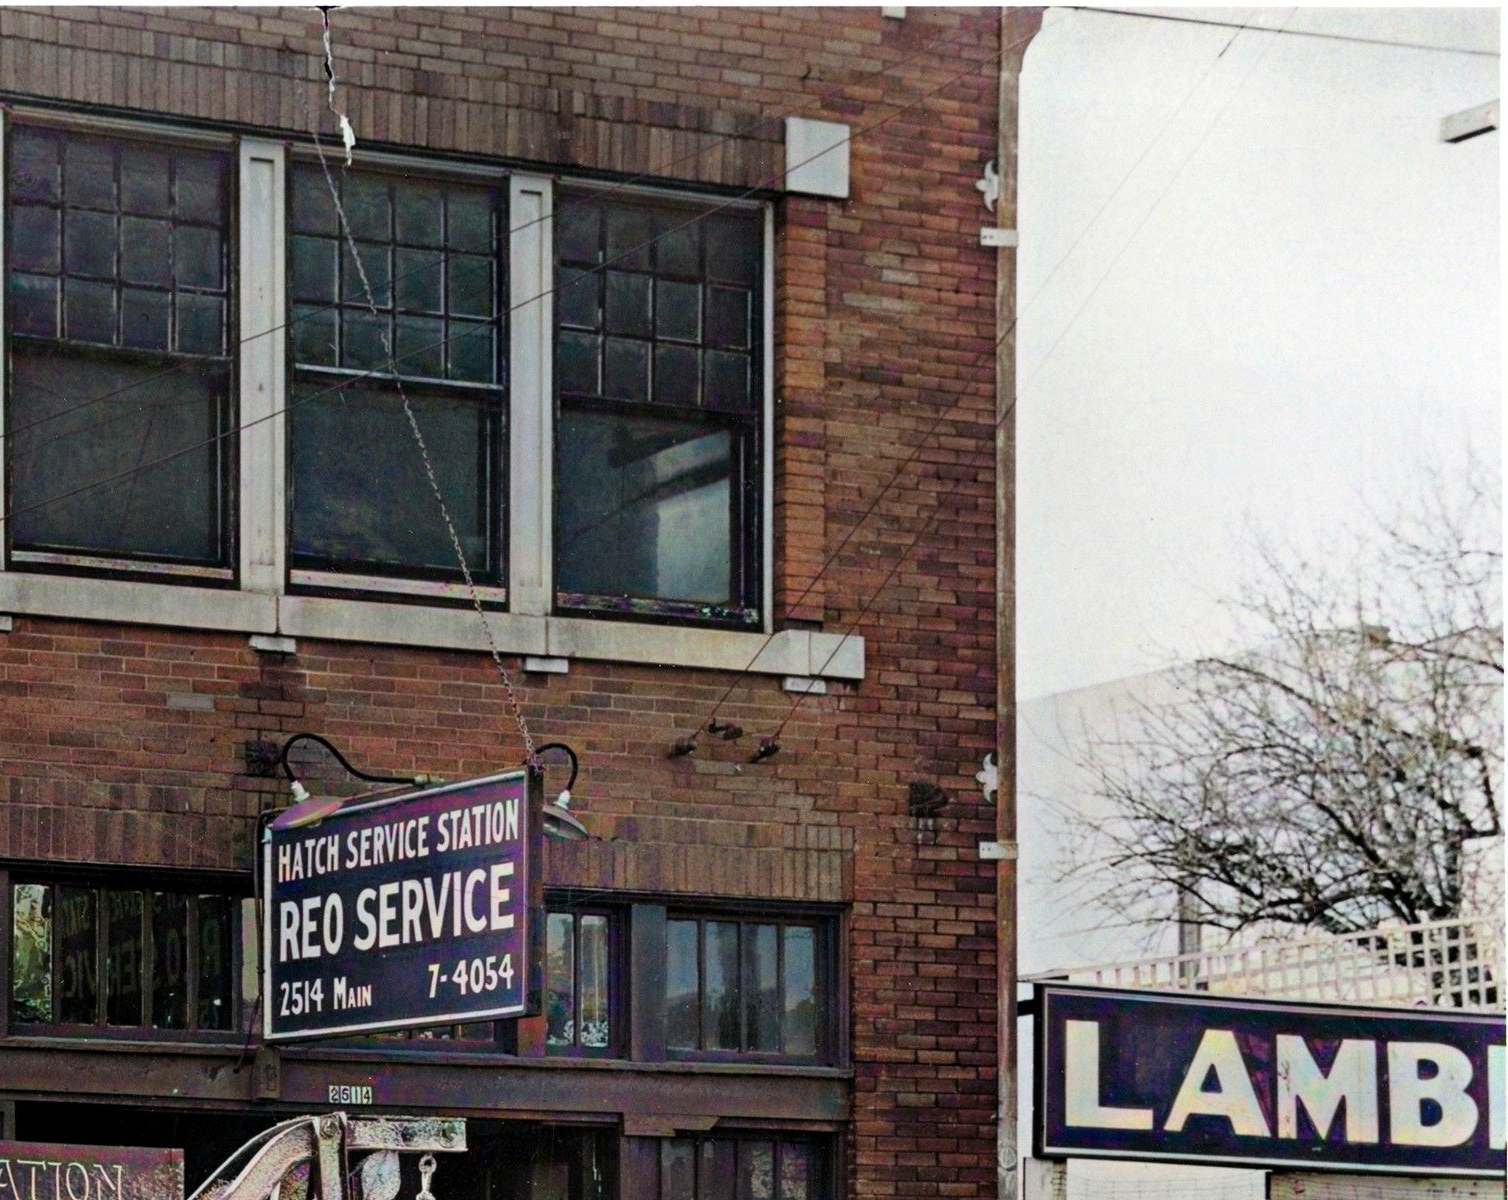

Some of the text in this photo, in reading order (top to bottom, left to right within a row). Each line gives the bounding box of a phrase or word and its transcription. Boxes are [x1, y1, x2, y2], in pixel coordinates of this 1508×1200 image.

[278, 798, 520, 883] HATCH SERVICE STATION
[280, 893, 342, 962] REO
[353, 862, 514, 950] SERVICE
[280, 976, 372, 1017] 2514 MAIN
[428, 954, 514, 999] 7-4054
